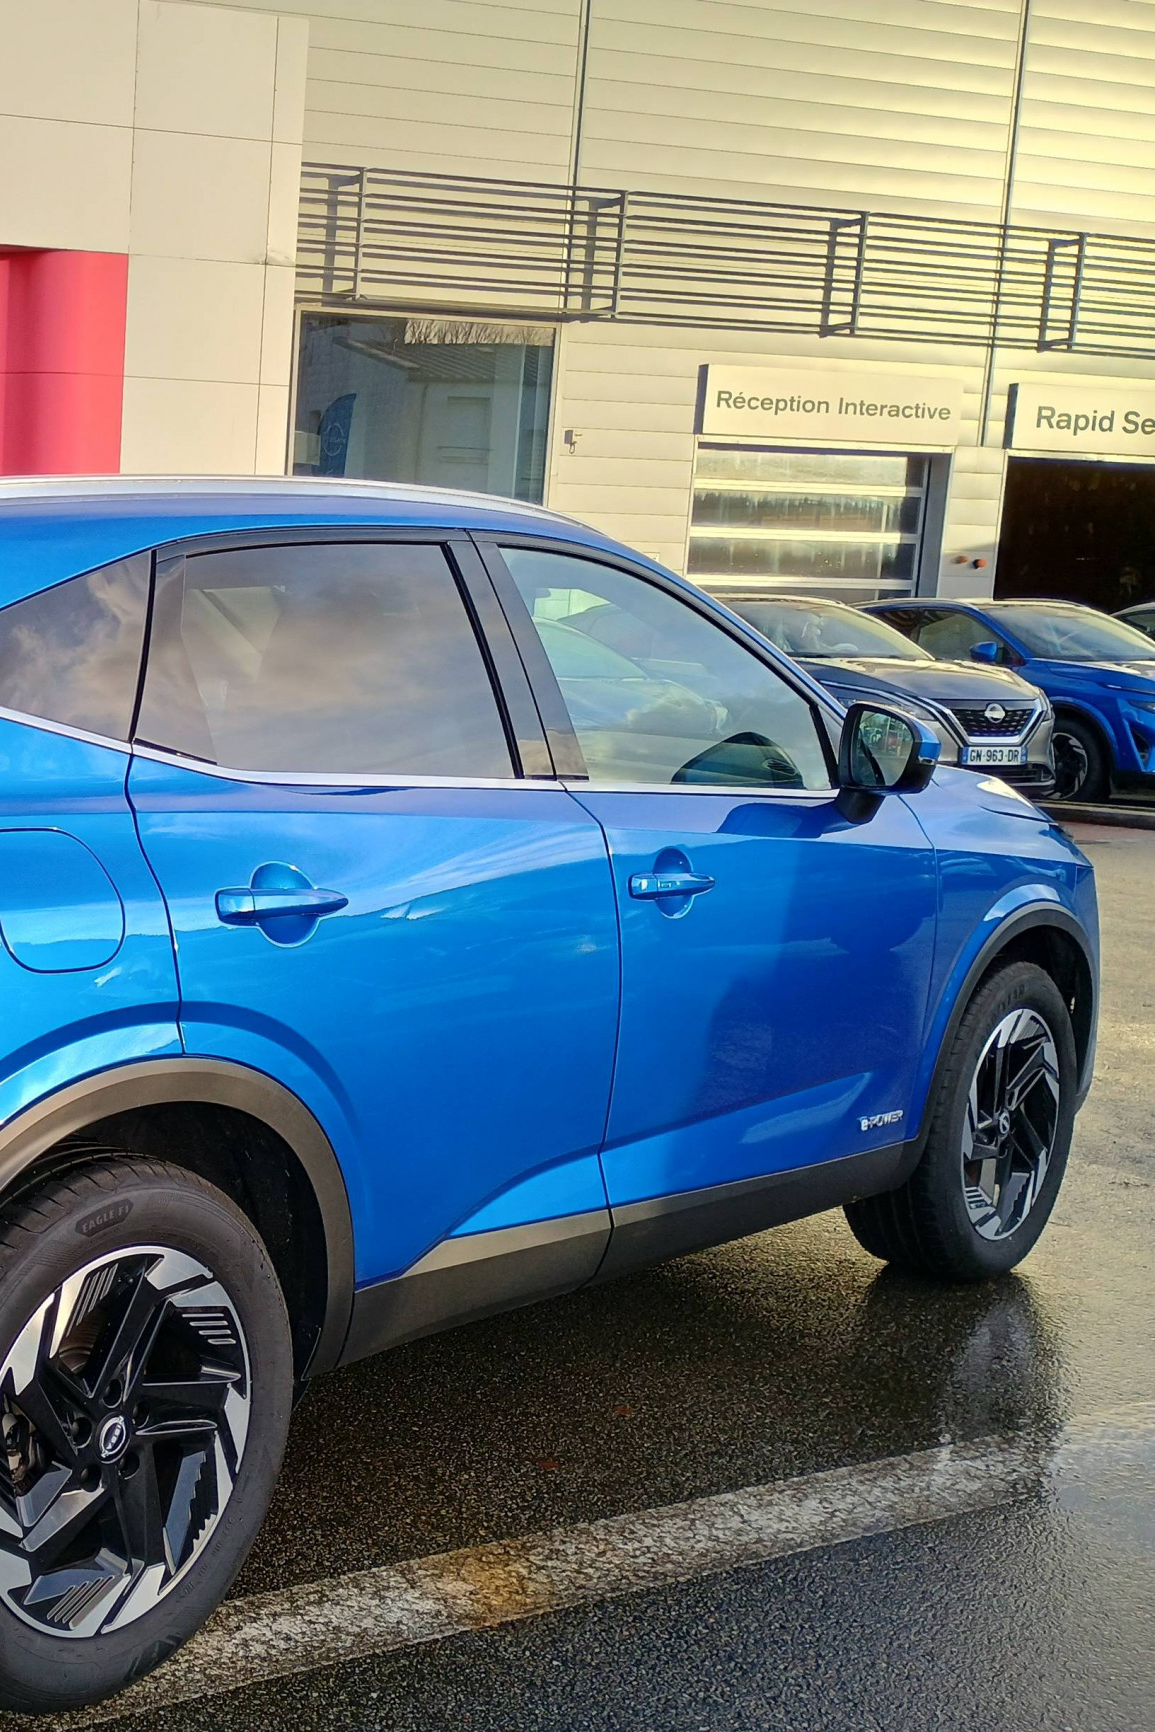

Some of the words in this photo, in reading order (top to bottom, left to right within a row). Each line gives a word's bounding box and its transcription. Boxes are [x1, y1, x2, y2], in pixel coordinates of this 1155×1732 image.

[716, 390, 830, 416] Réception
[838, 397, 952, 421] Interactive
[1035, 405, 1115, 437] Rapid
[82, 1209, 115, 1233] EAGLE
